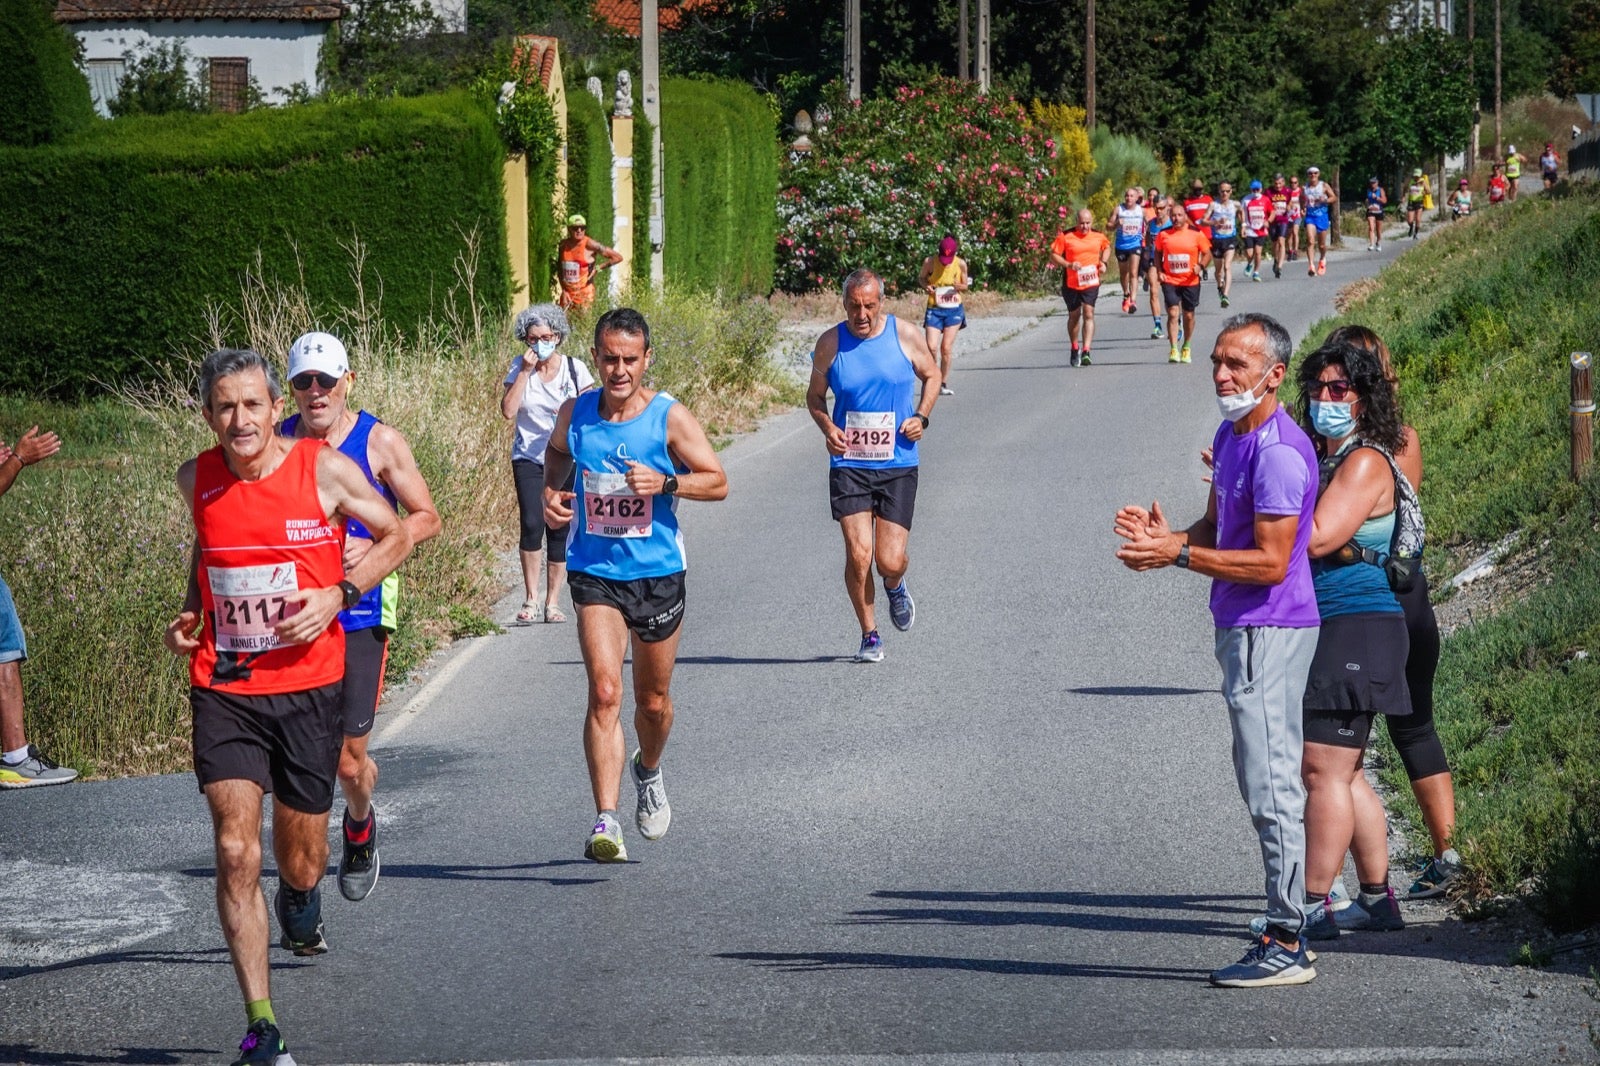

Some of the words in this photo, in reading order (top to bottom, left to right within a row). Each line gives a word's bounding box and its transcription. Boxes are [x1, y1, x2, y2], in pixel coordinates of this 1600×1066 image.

[852, 430, 890, 445] 2192
[593, 497, 645, 518] 2162
[286, 525, 333, 541] VAMPIROS
[223, 596, 286, 625] 2117
[230, 636, 258, 649] MANUEL
